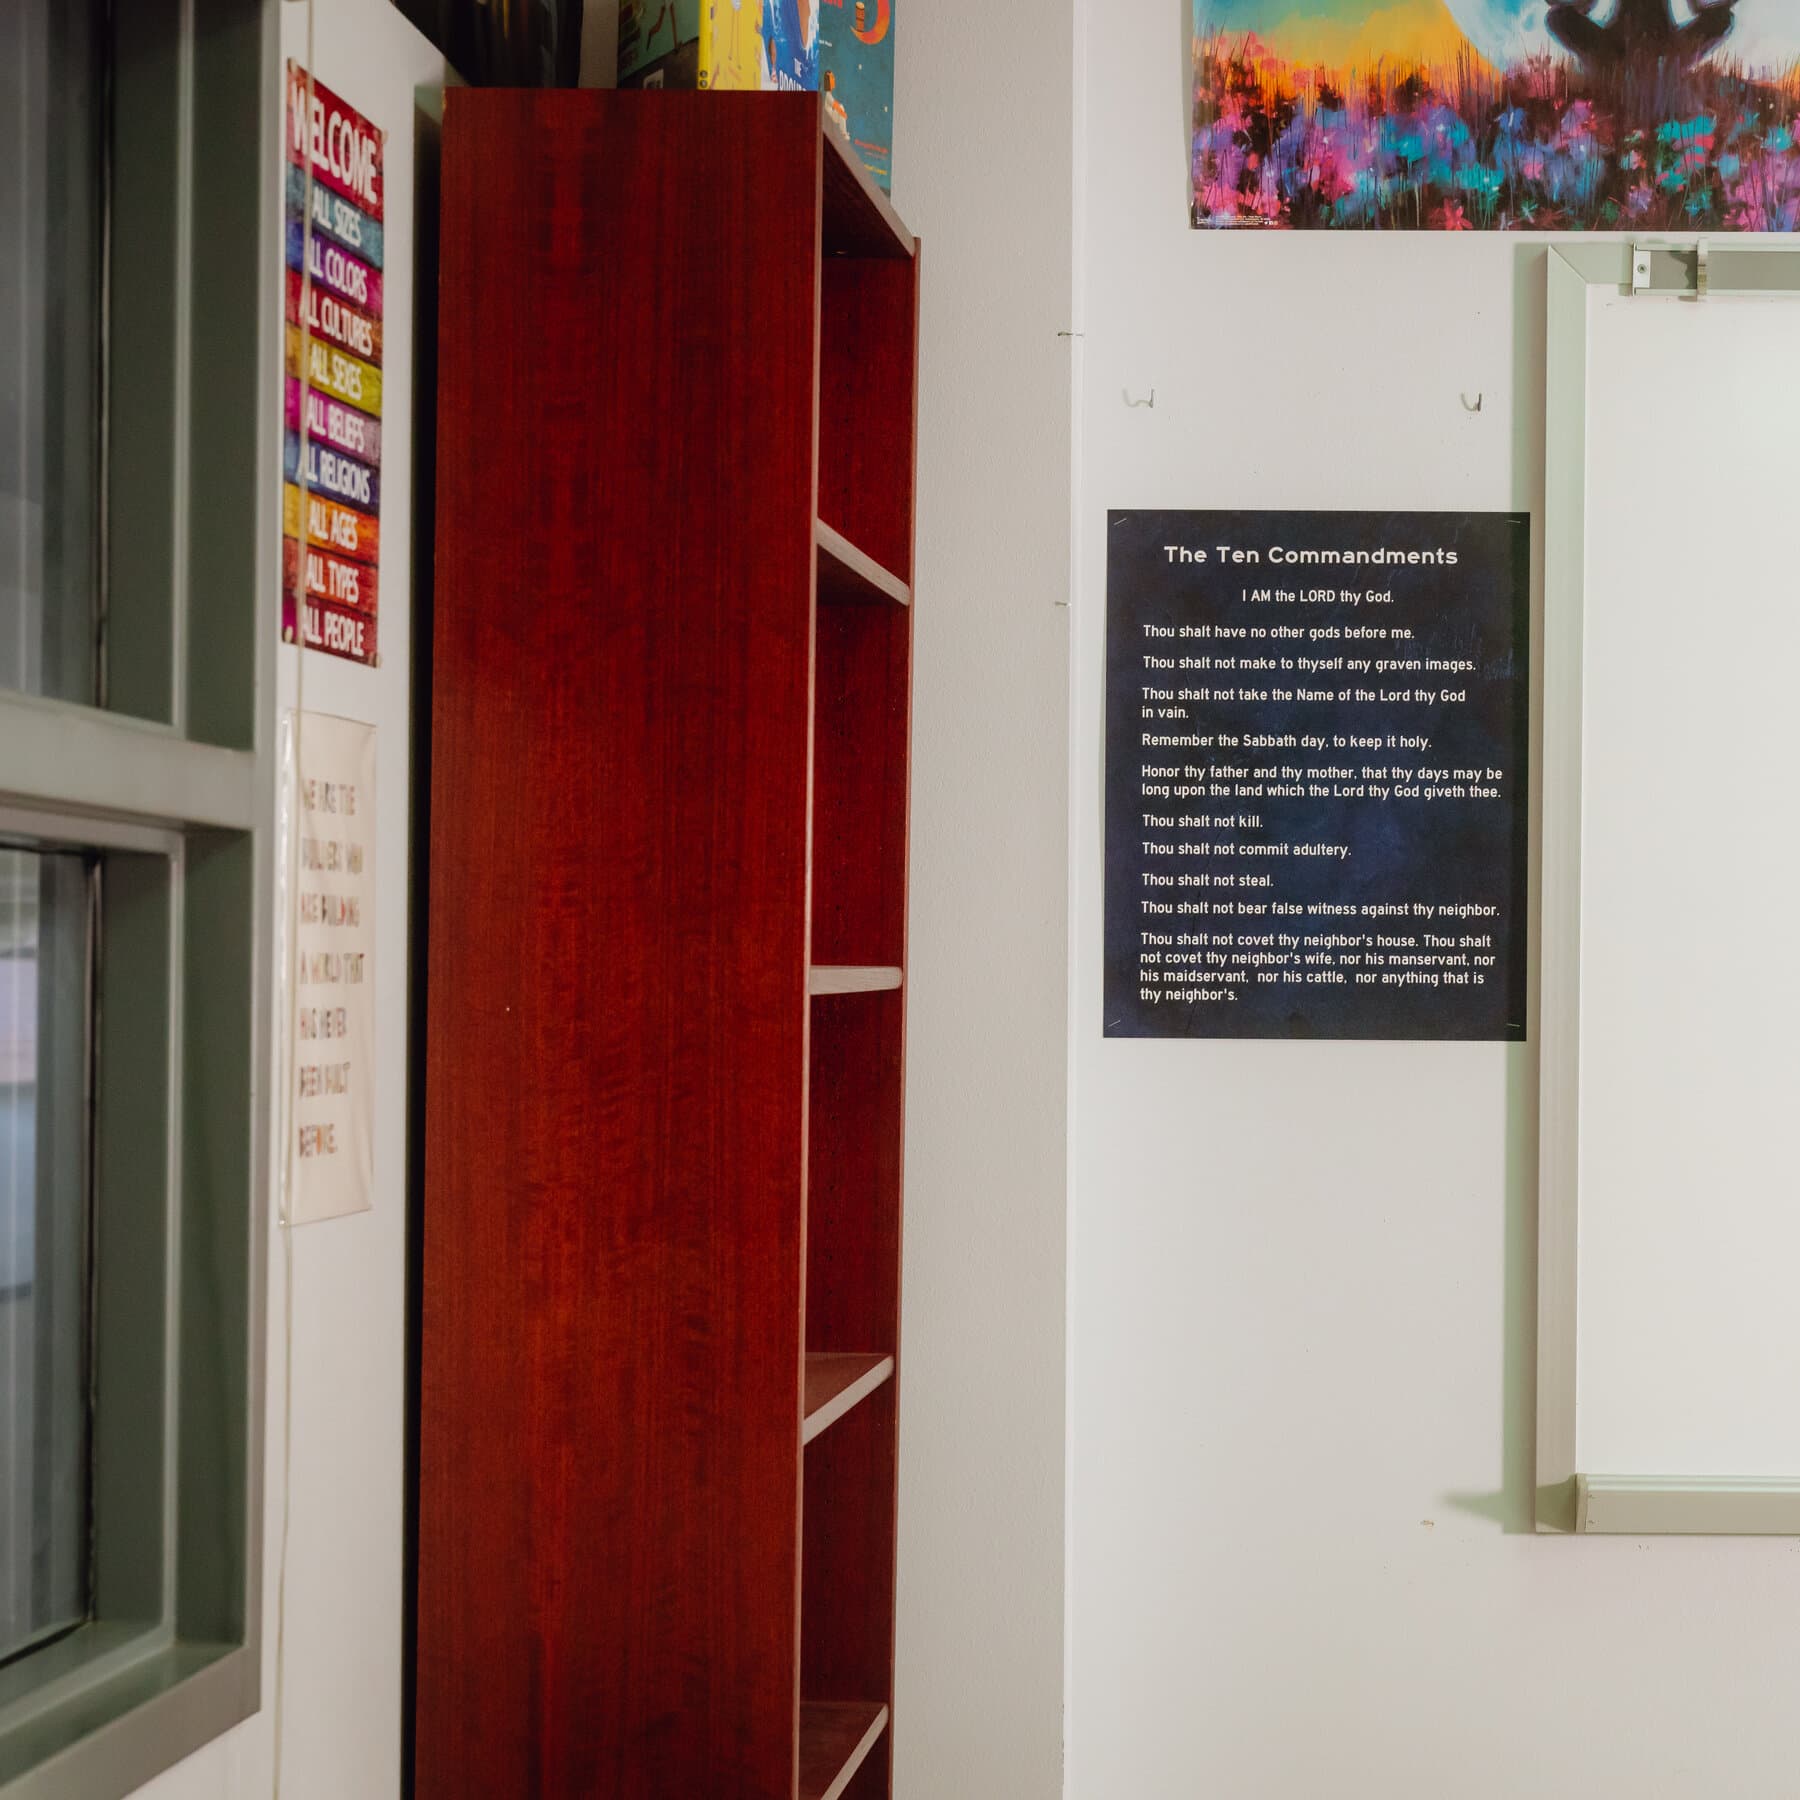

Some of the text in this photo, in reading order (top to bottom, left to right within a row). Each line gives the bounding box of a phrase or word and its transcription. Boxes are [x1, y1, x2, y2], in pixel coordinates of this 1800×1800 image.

[291, 81, 379, 204] WELCOME
[311, 186, 362, 247] ALL SIZES
[325, 248, 368, 304] COLORS
[321, 296, 373, 357] CULTURES
[311, 342, 363, 401] ALL SEXES
[307, 394, 365, 453] ALL BELIEFS
[319, 449, 371, 505] RELIGIONS
[308, 500, 358, 551] ALL AGES
[1163, 545, 1458, 565] The Ten Commandments
[306, 553, 360, 603] ALL TYPES
[1242, 588, 1395, 607] I AM the LORD thy God.
[302, 604, 365, 657] ALL PEOPLE
[1142, 624, 1415, 642] Thou shalt have no other gods before me.
[1142, 655, 1477, 674] Thou shalt not make to thyself any graven images.
[1141, 686, 1466, 706] Thou shalt not take the Name of the Lord thy God
[1141, 705, 1189, 719] in vain.
[1141, 732, 1432, 752] Remember the Sabbath day, to keep it holy.
[1141, 764, 1503, 784] Honor thy father and thy mother, that thy days may be
[1141, 782, 1501, 801] long upon the land which the Lord thy God giveth thee.
[1142, 813, 1264, 828] Thou shalt not kill.
[1141, 841, 1352, 860] Thou shalt not commit adultery.
[1141, 872, 1274, 887] Thou shalt not steal.
[1140, 900, 1500, 920] Thou shalt not bear false witness against thy neighbor.
[1140, 931, 1492, 950] Thou shalt not covet thy neighbor's house. Thou shalt
[1139, 950, 1496, 968] not covet thy neighbor's wife, nor his manservant, nor
[1139, 968, 1485, 988] his maidservant, nor his cattle, nor anything that is
[1139, 987, 1238, 1005] thy neighbor's.
